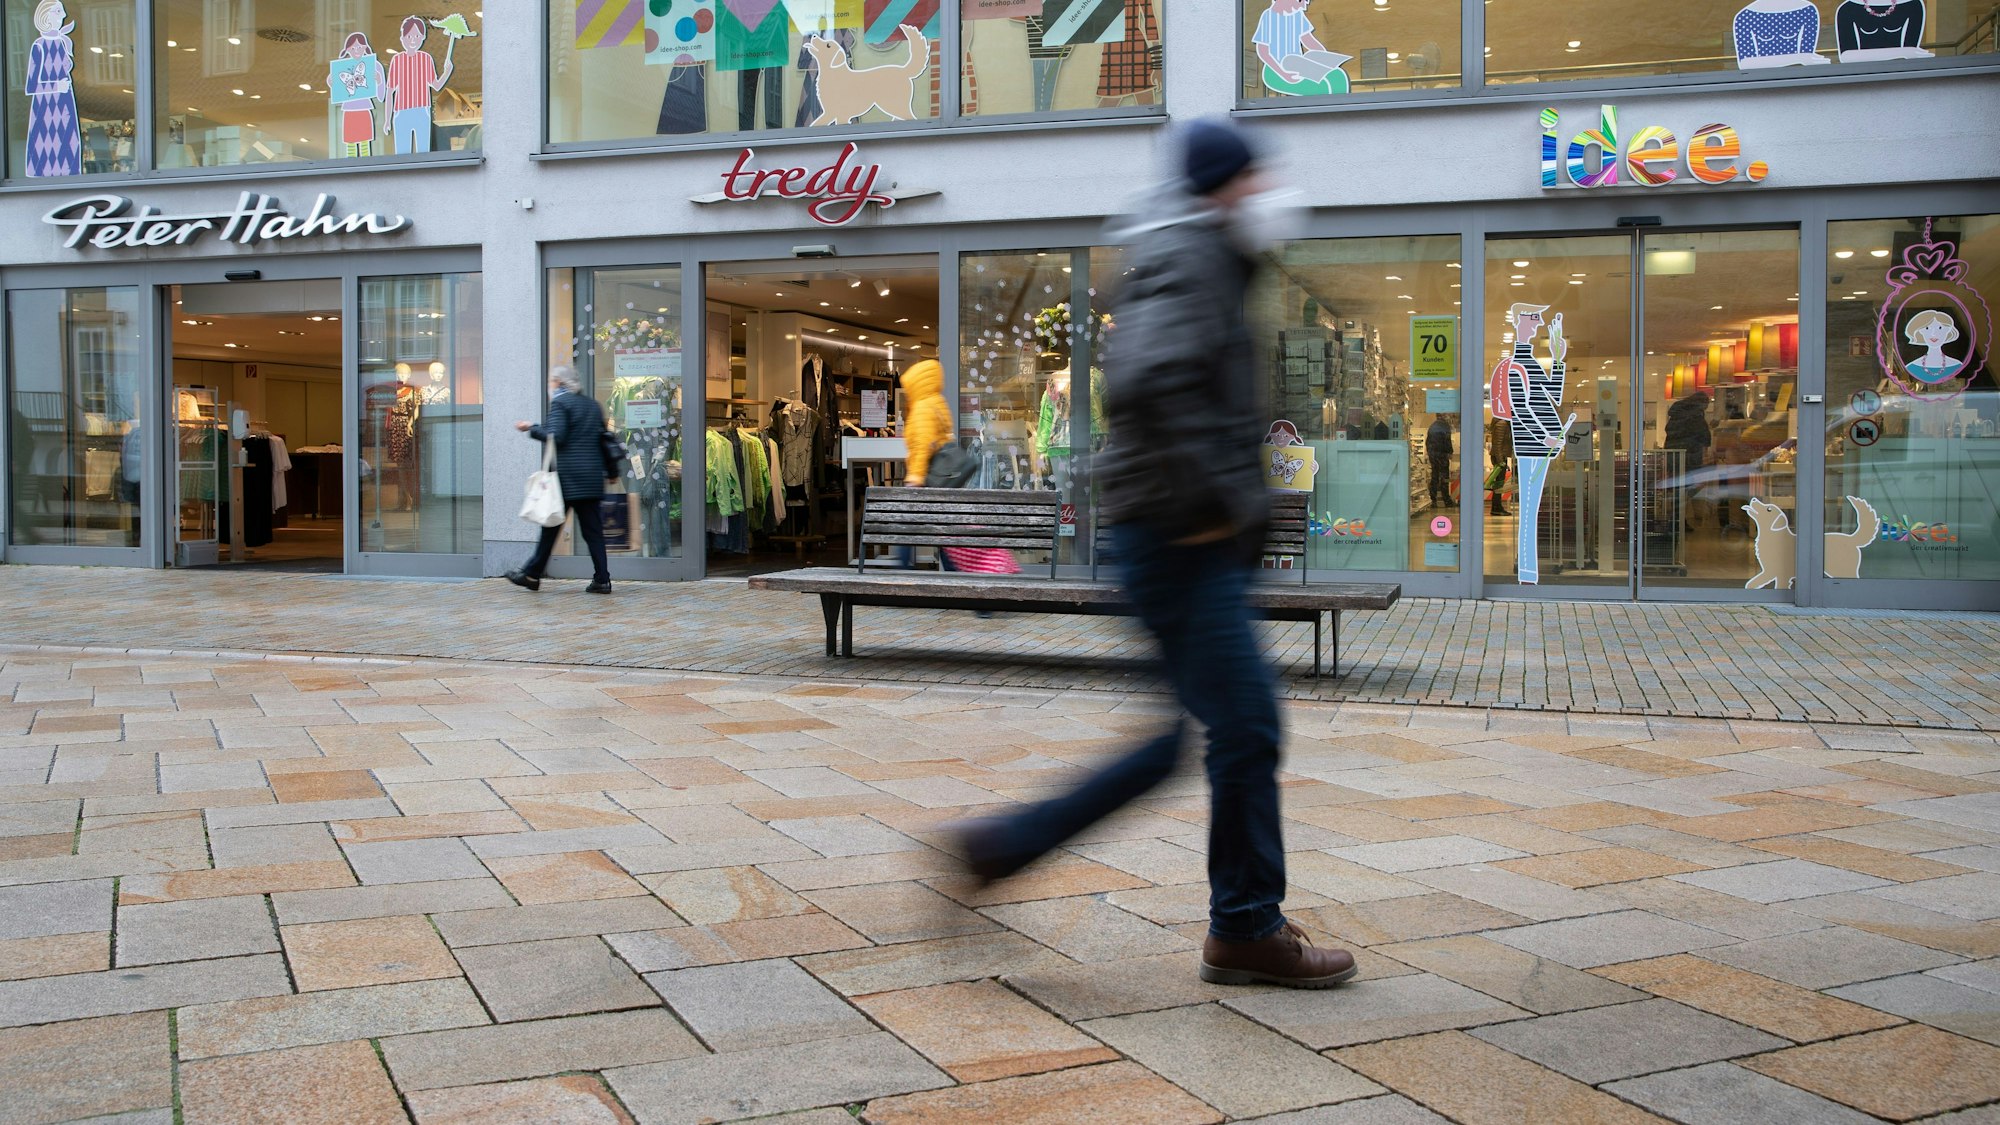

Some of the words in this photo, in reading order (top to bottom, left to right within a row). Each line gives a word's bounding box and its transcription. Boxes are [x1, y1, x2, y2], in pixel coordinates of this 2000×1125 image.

[978, 0, 1026, 8] idee-shop.com
[1069, 0, 1094, 24] idee-sho
[659, 43, 703, 53] idee-shop.com
[730, 50, 775, 59] idee-shop.com
[1540, 104, 1769, 188] idee.
[720, 142, 896, 226] tredy
[41, 194, 213, 248] Peter
[219, 190, 407, 245] Hahn
[1420, 334, 1448, 354] 70
[1309, 510, 1372, 537] idee.
[1882, 514, 1957, 542] idee.
